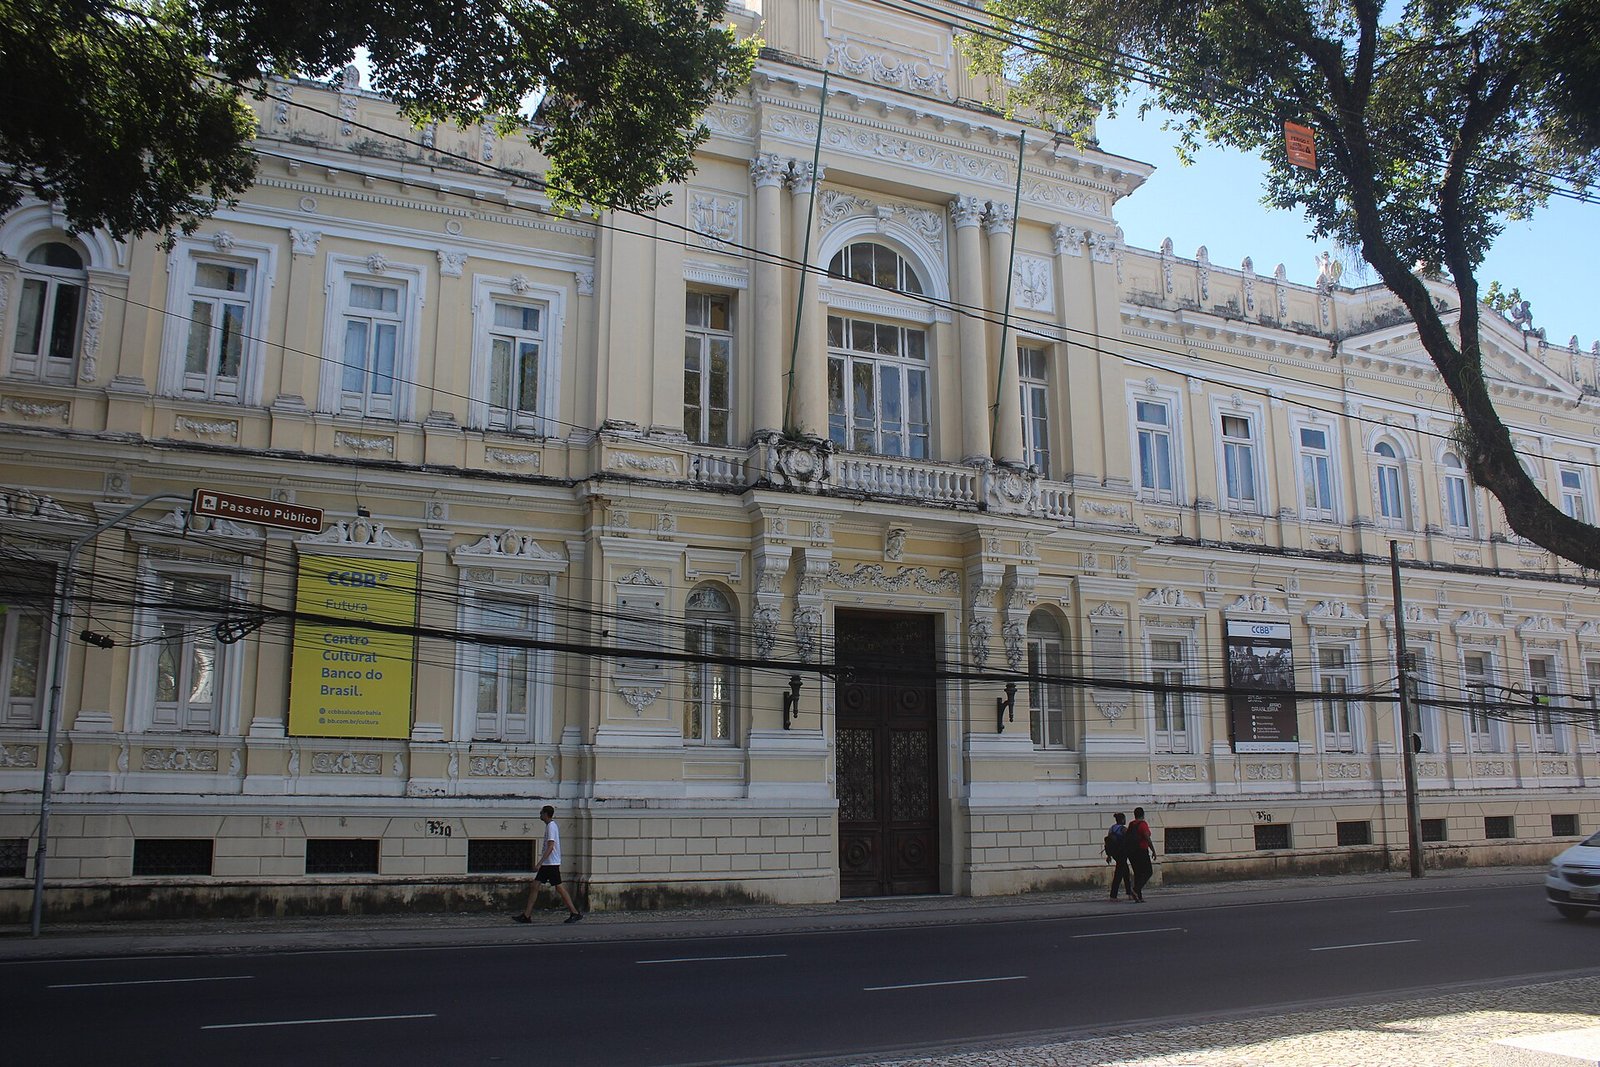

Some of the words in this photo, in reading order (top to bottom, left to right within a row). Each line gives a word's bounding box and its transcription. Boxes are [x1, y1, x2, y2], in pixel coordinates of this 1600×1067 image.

[220, 500, 271, 517] Passeio
[274, 509, 318, 525] Público
[327, 571, 377, 588] CCBB
[326, 599, 368, 612] Futura
[1251, 625, 1270, 635] CCBB
[323, 633, 369, 646] Centro
[322, 649, 377, 663] Cultural
[321, 667, 362, 680] Banco
[365, 669, 383, 680] do
[320, 684, 363, 697] Brasil.
